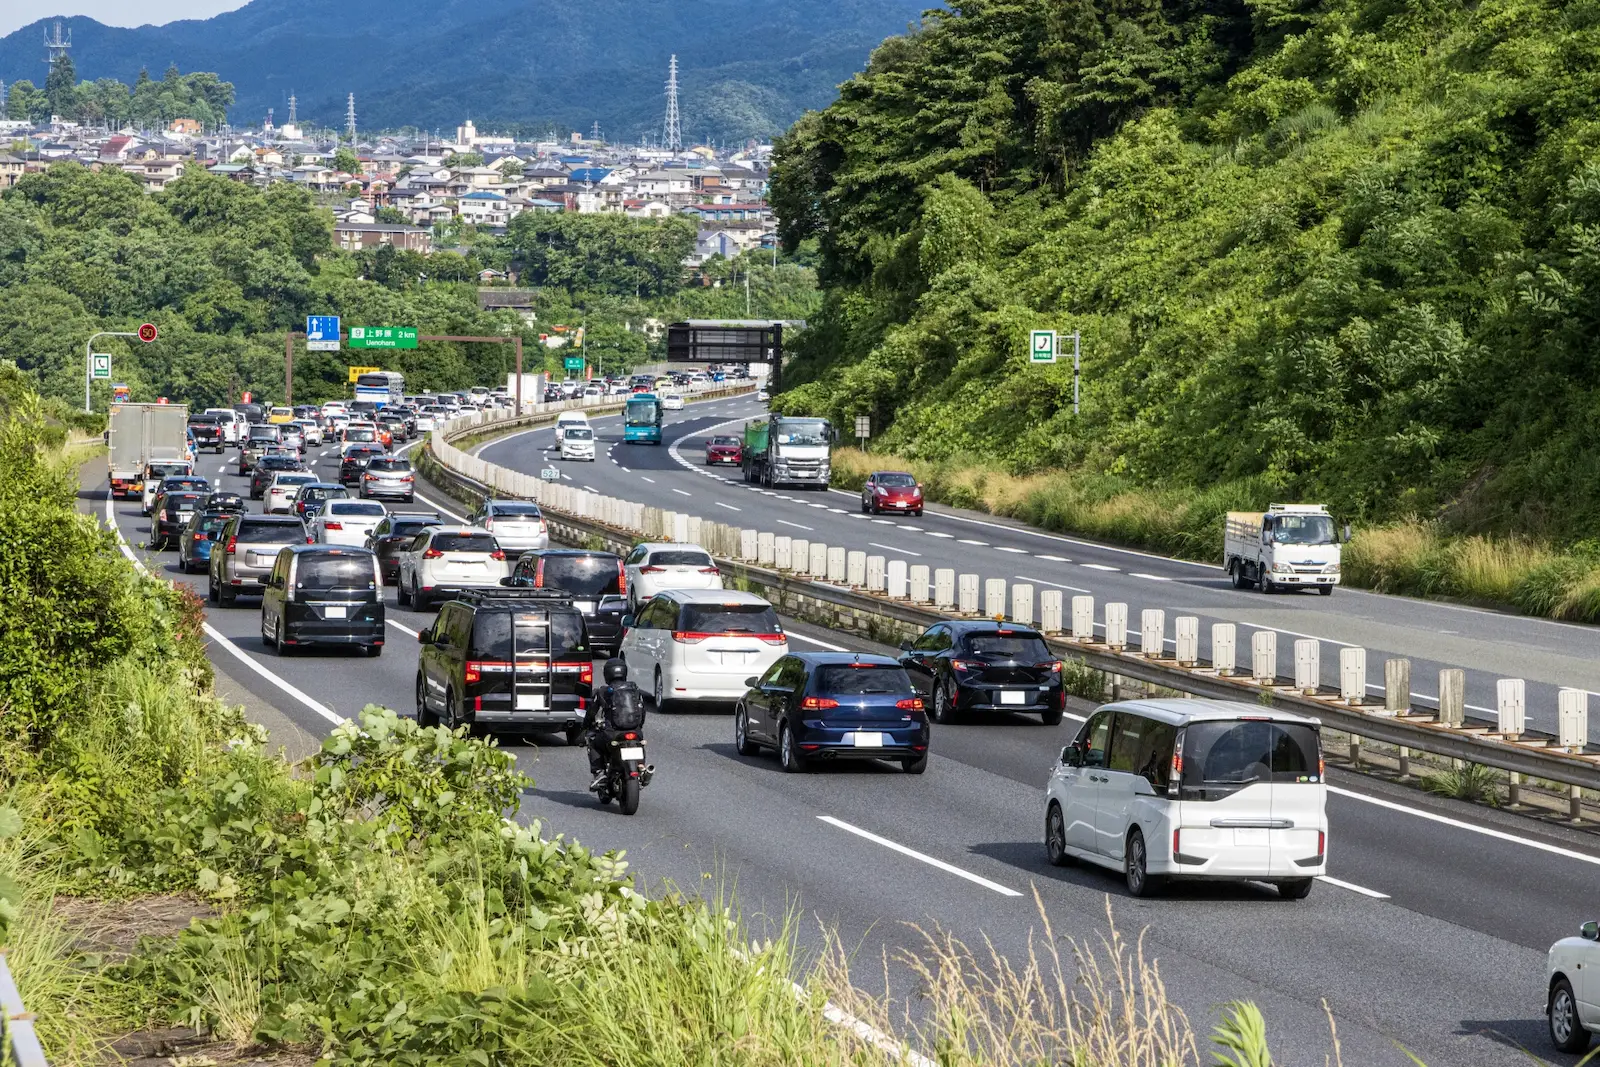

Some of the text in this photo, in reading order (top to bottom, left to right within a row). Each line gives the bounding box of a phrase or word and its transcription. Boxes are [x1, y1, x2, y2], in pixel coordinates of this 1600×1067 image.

[142, 328, 153, 338] 50
[355, 329, 361, 337] 9
[366, 329, 392, 338] 上野原
